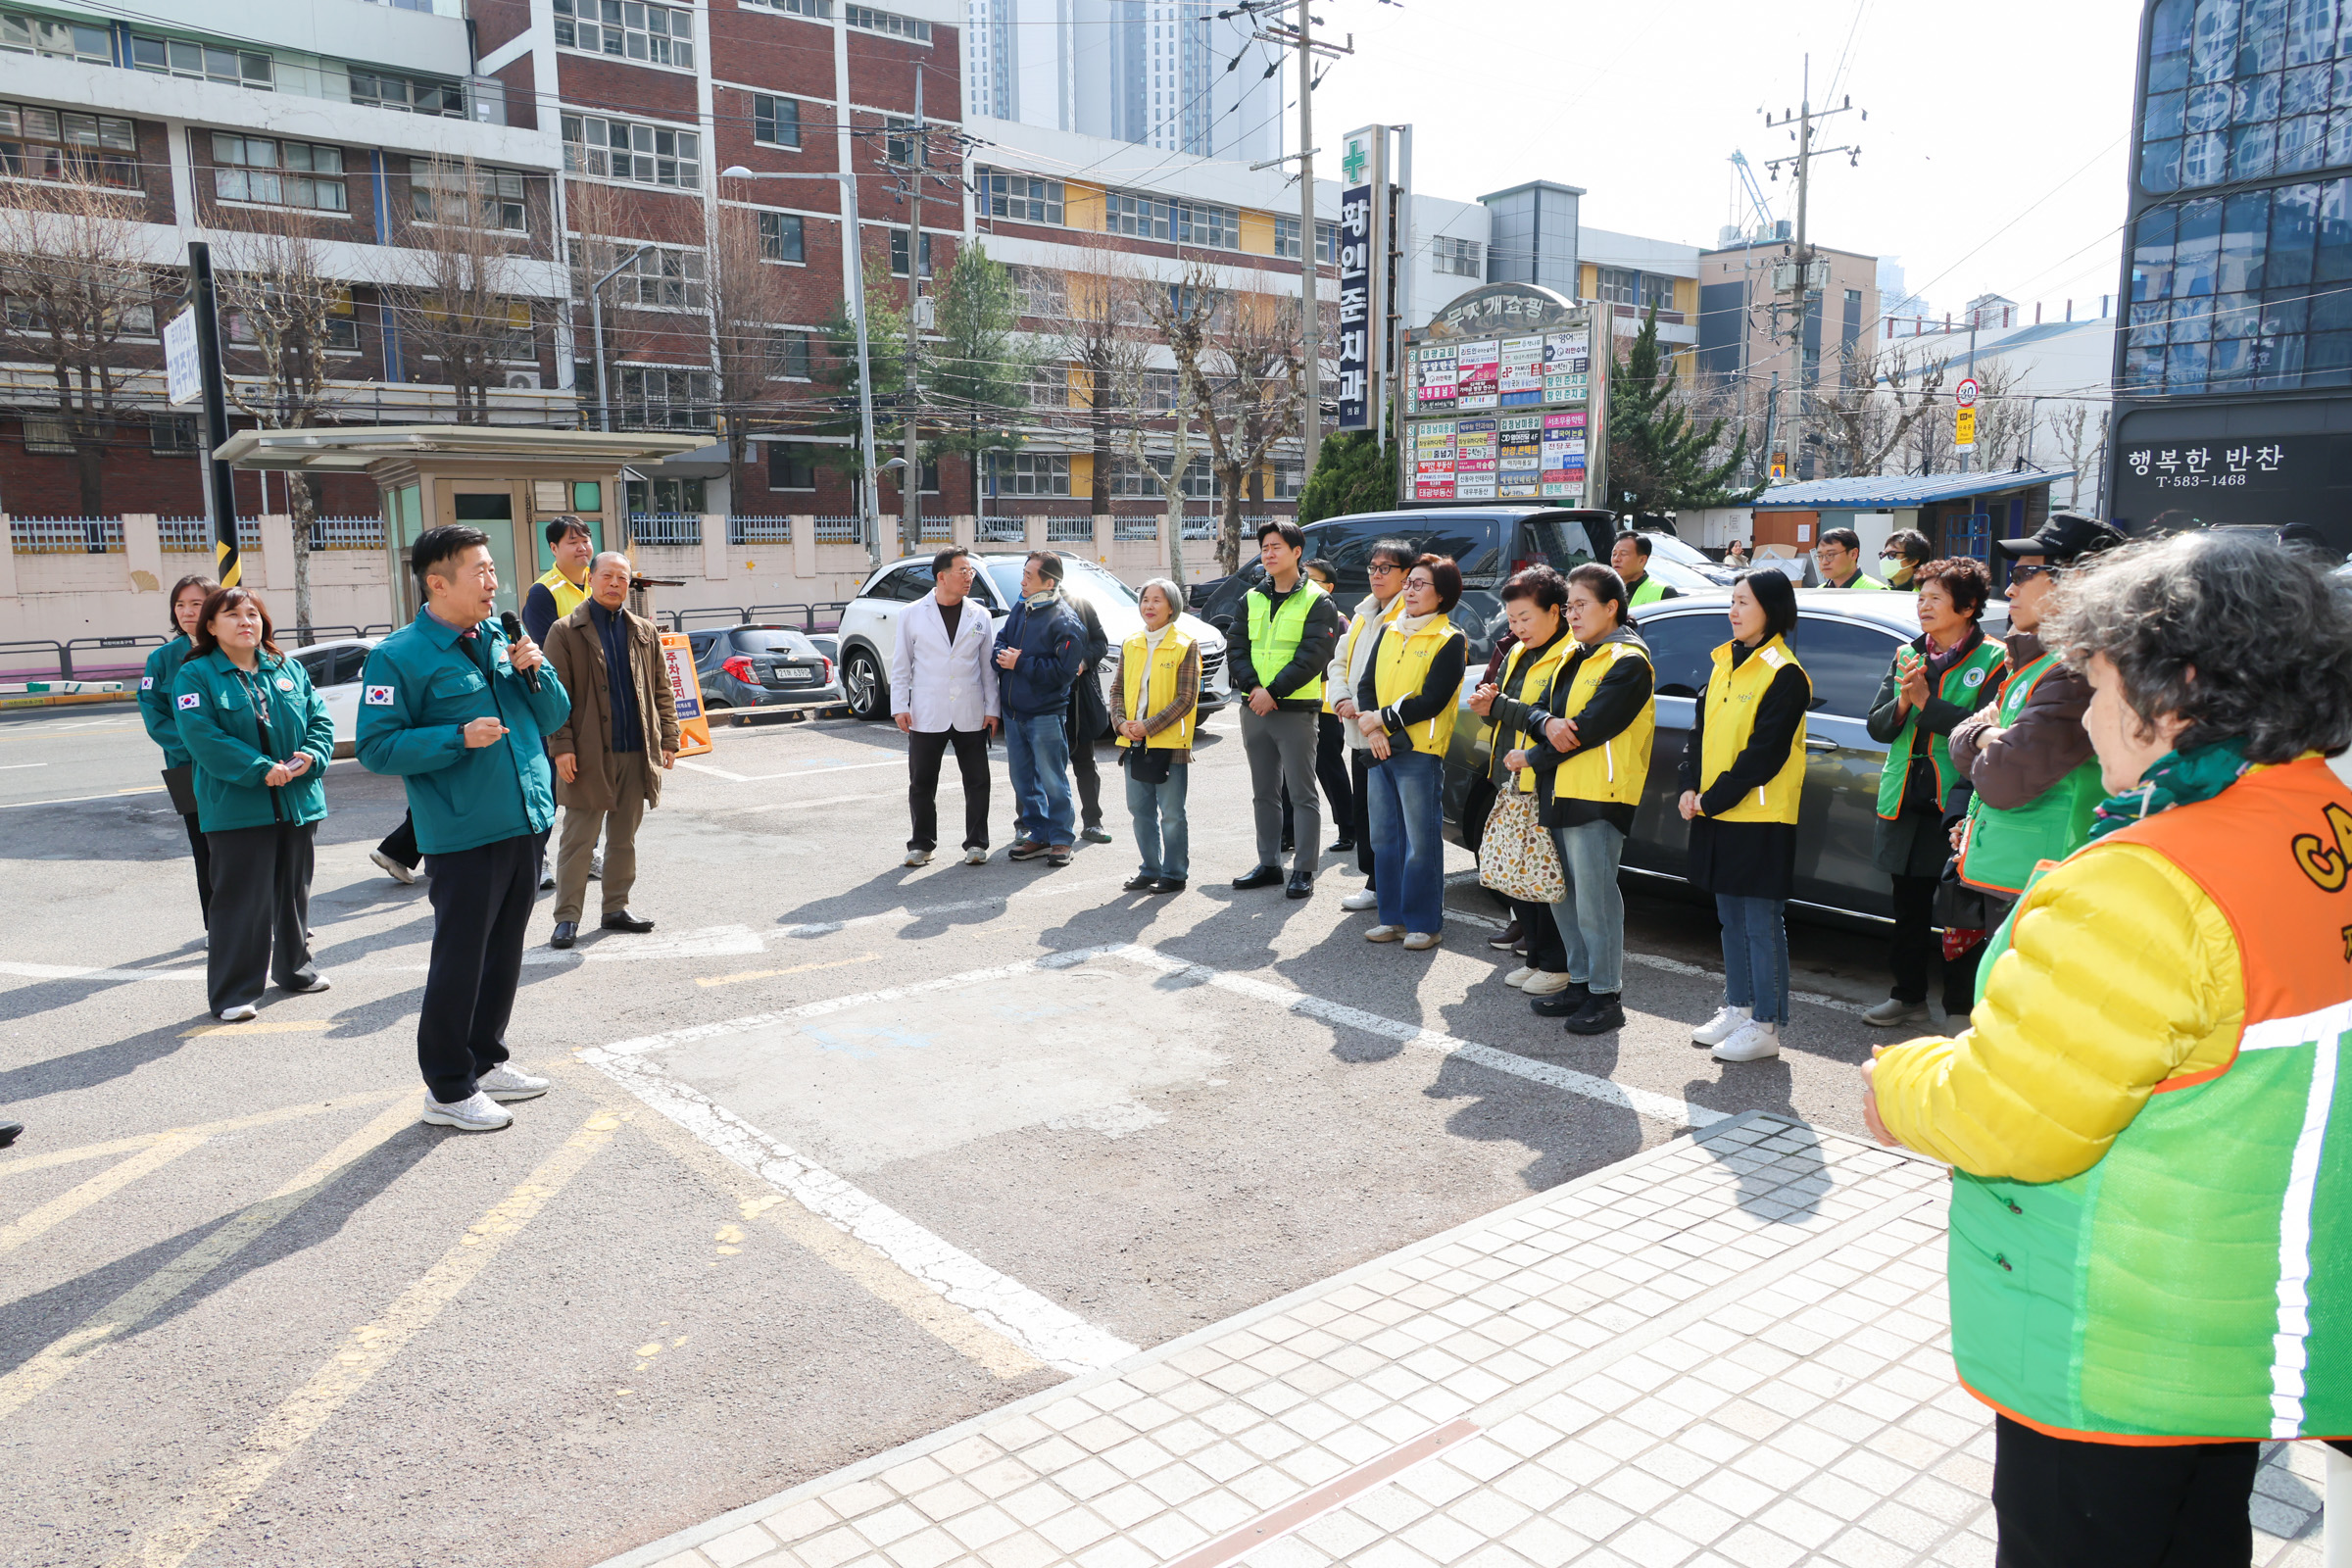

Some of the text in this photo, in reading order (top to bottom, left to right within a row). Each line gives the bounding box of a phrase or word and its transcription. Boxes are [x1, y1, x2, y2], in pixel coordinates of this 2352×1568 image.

[1340, 199, 1370, 403] 황인준치과
[1446, 295, 1544, 329] 무지개쇼핑
[1559, 333, 1574, 343] 영어
[1409, 351, 1415, 362] 6
[1423, 347, 1454, 360] 대광교회
[1409, 389, 1414, 399] 3
[1961, 387, 1973, 399] 30
[1347, 407, 1359, 416] 의원
[1408, 402, 1414, 412] 3
[1548, 416, 1584, 425] 서초무용학원
[2129, 444, 2284, 475] 행복한 반찬
[1418, 488, 1453, 497] 태광부동산
[1546, 483, 1581, 494] 행복 약국
[666, 652, 685, 699] 주차금지
